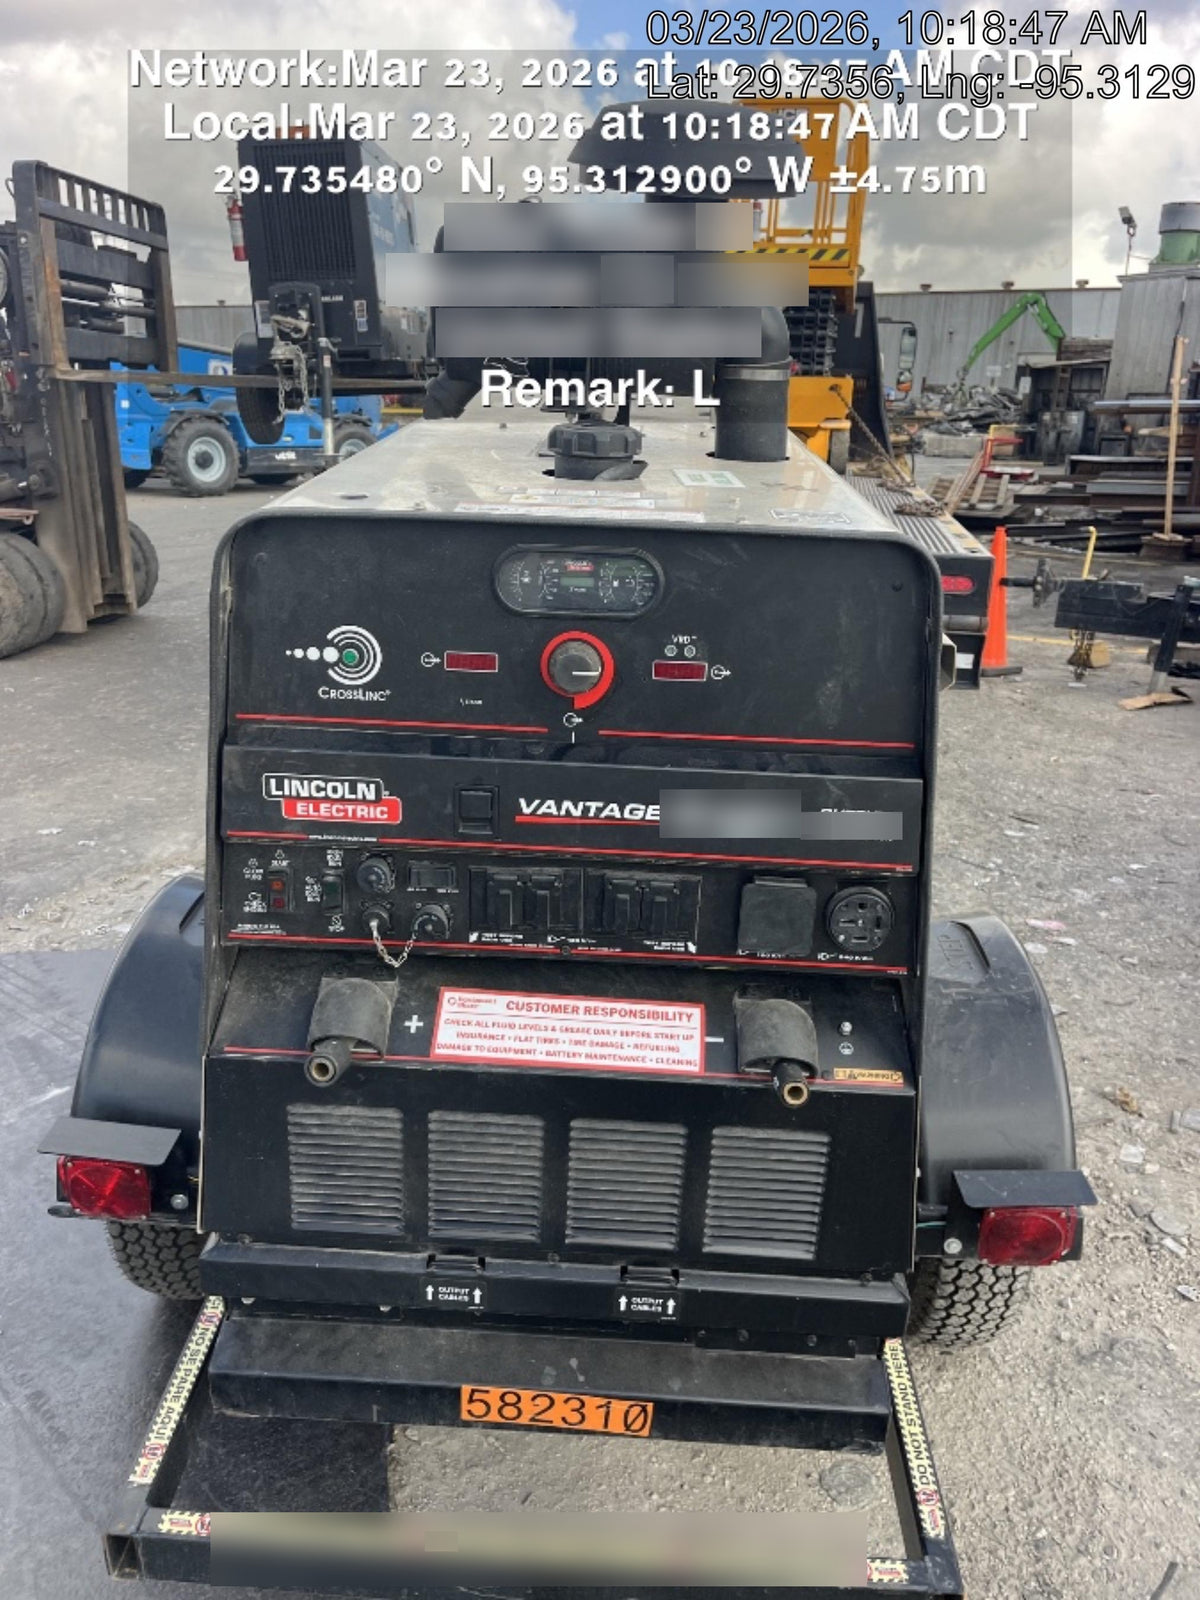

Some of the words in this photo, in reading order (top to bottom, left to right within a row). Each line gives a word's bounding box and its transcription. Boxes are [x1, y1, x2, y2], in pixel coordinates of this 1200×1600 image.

[268, 777, 378, 802] LINCOLN
[295, 801, 389, 820] ELECTRIC
[518, 797, 660, 821] VANTAGE
[505, 1000, 580, 1015] CUSTOMER
[584, 1005, 694, 1023] RESPONSIBILITY
[466, 1387, 650, 1434] 582310
[897, 1382, 917, 1427] STAND
[907, 1430, 925, 1461] NOT
[917, 1464, 931, 1486] DO
